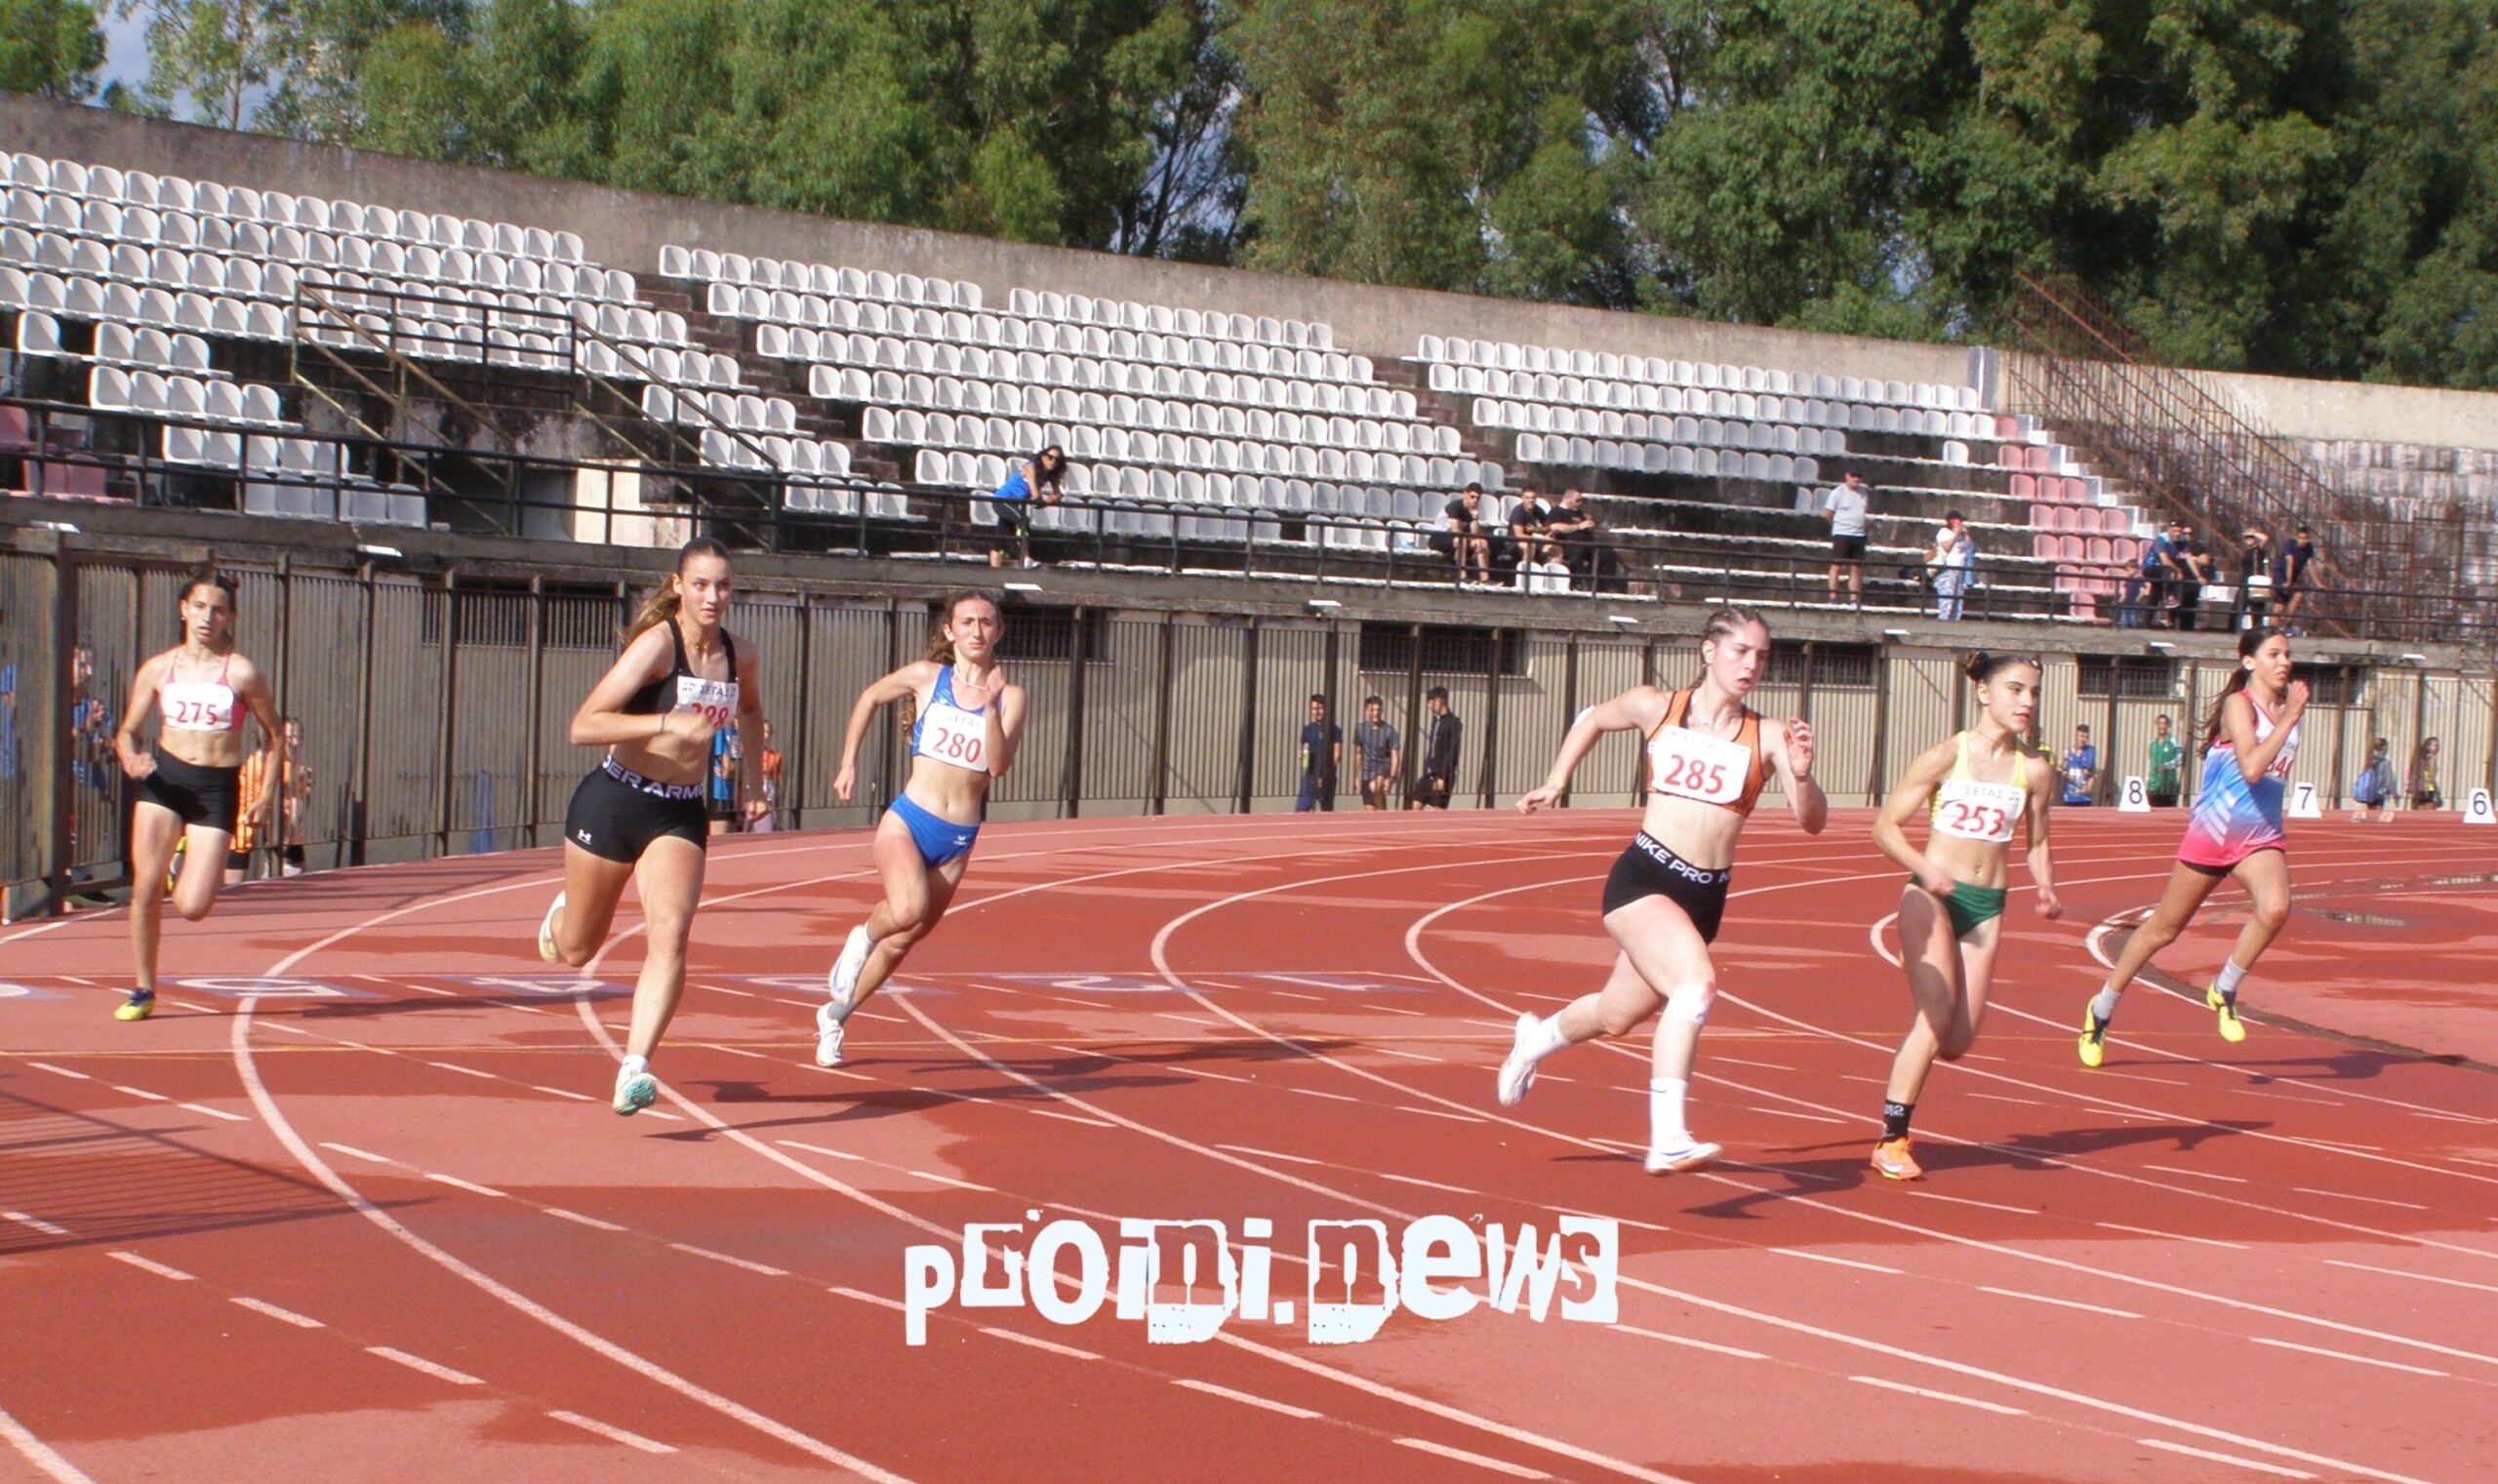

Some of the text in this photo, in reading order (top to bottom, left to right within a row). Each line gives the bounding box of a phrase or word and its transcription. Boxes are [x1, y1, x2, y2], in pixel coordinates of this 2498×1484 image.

[176, 701, 219, 726] 275
[933, 727, 982, 764] 280
[1664, 753, 1726, 795] 285
[2128, 781, 2143, 805] 8
[2298, 786, 2313, 811] 7
[2473, 791, 2487, 816] 6
[1951, 803, 2006, 836] 253
[1634, 831, 1672, 864] NIKE
[1669, 859, 1713, 885] PRO
